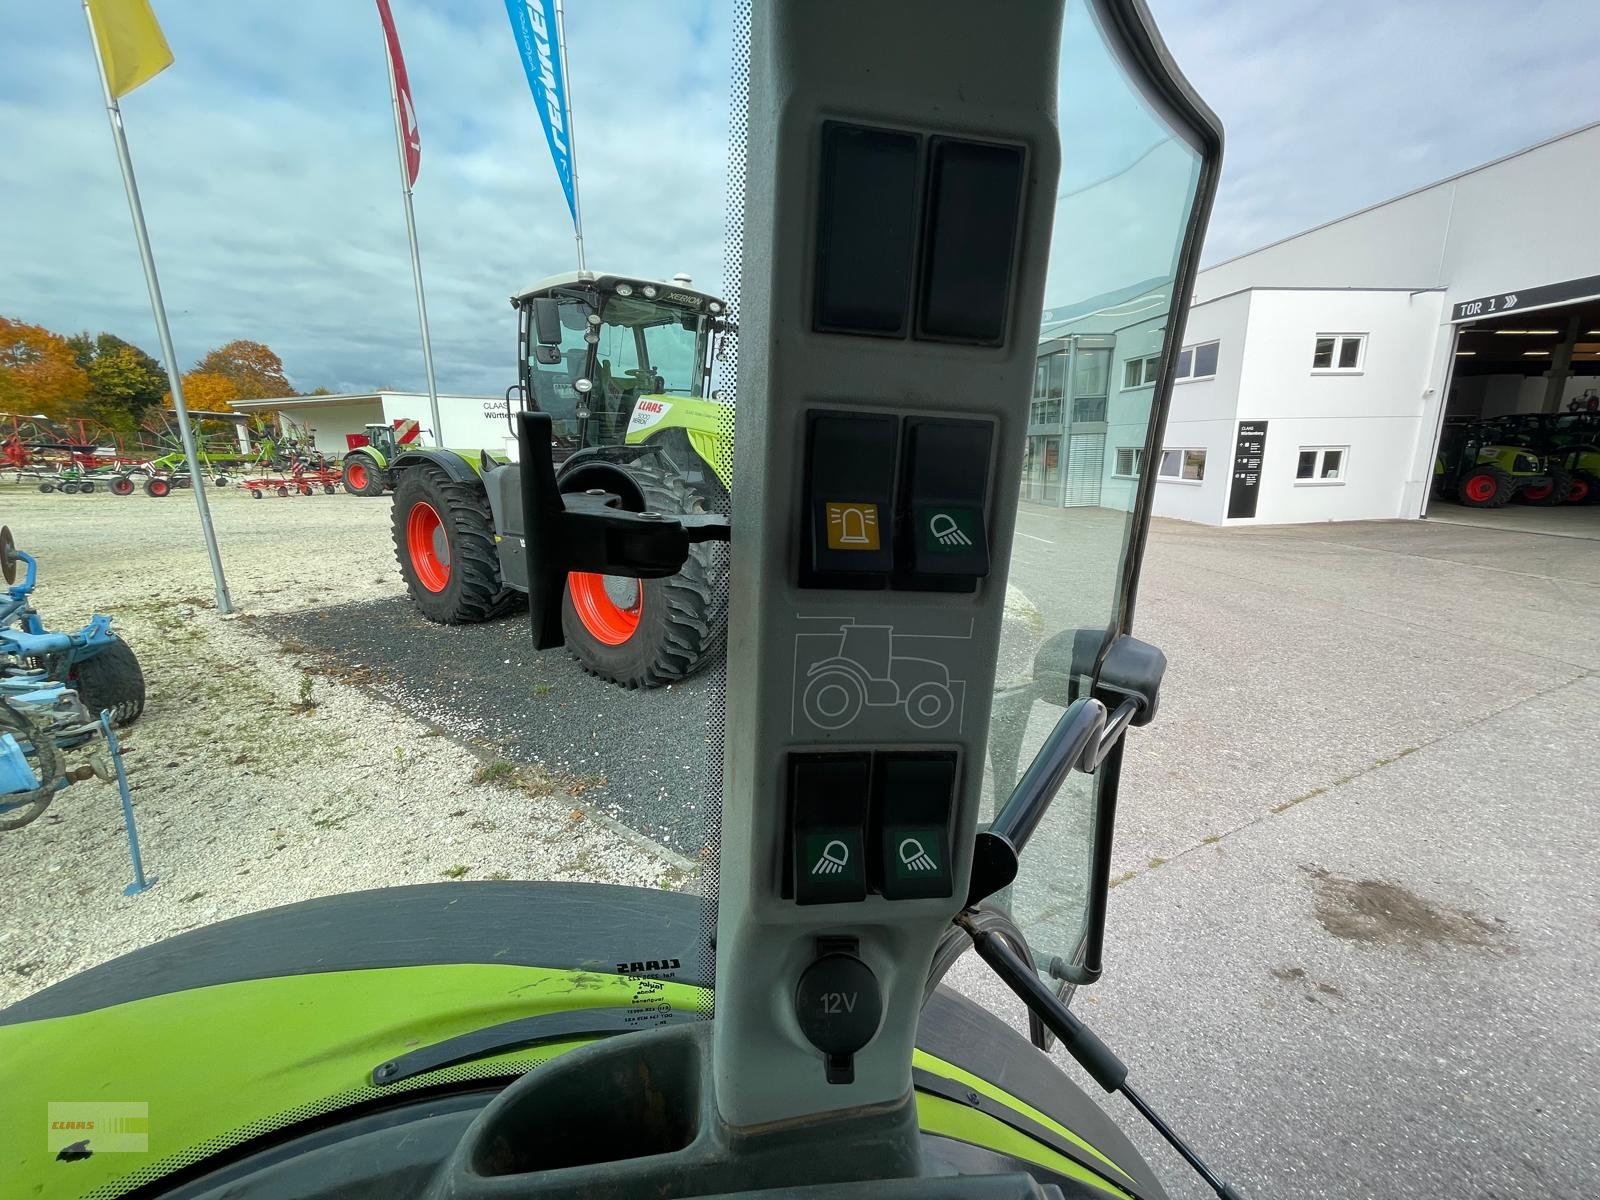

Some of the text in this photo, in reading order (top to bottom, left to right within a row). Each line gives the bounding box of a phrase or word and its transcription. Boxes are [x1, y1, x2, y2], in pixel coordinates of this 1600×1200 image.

[667, 292, 703, 305] XERION
[1460, 299, 1496, 316] TOR 1
[484, 402, 508, 410] CLAAS
[638, 401, 663, 413] CLAAS
[820, 992, 858, 1014] 12V
